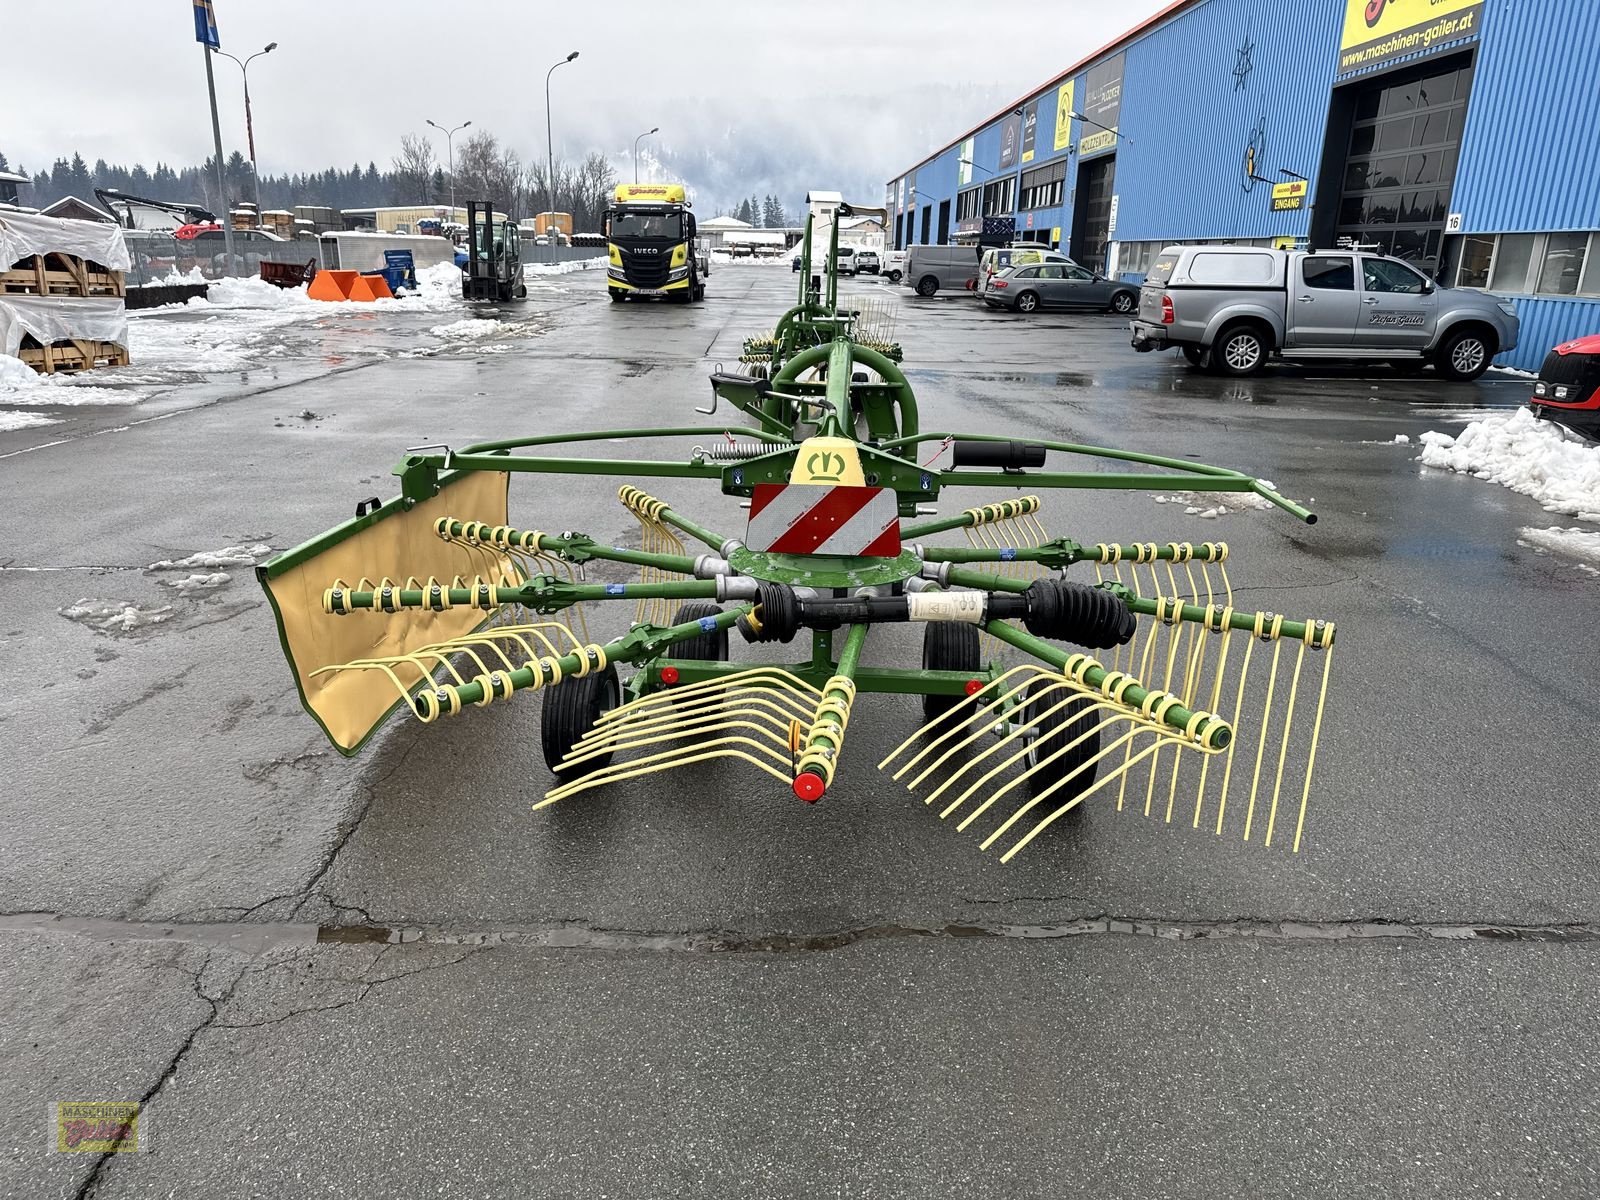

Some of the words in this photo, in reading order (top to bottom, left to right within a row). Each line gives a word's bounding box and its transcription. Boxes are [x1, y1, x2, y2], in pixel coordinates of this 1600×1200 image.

[1342, 11, 1474, 67] www.maschinen-gailer.at
[1274, 198, 1300, 210] EINGANG
[1450, 217, 1459, 229] 16
[1369, 314, 1397, 325] Stefan
